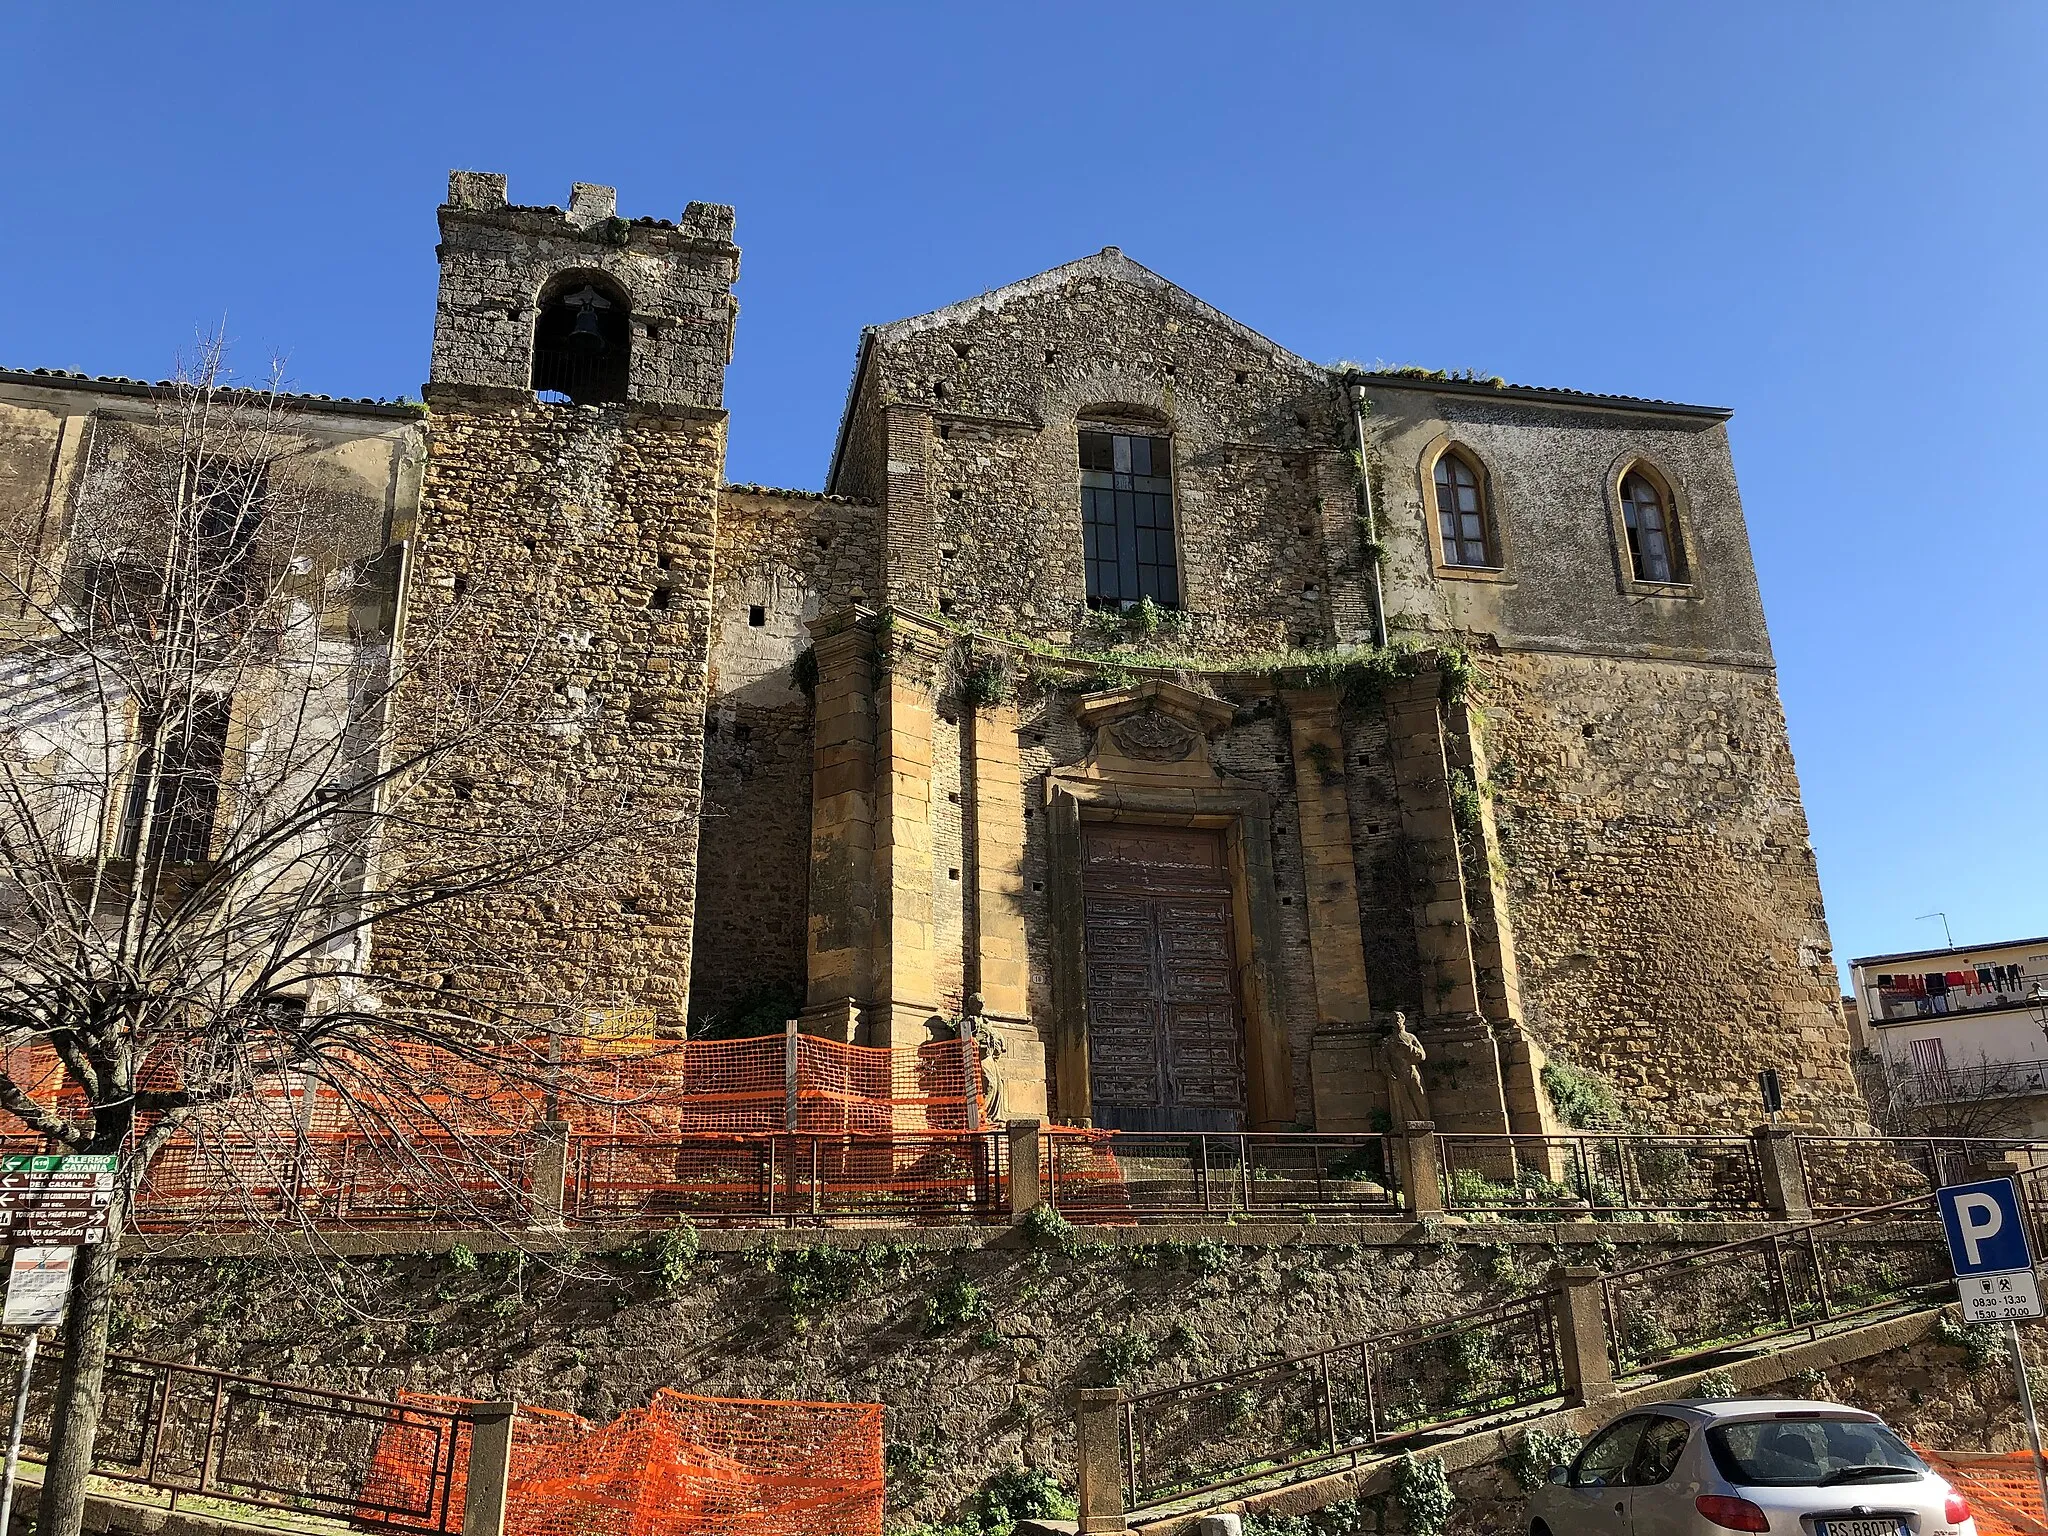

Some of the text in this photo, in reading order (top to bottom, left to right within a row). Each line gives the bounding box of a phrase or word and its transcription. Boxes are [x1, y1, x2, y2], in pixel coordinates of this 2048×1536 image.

[61, 1156, 111, 1164] PALERMO
[1953, 1192, 2003, 1266] P
[1972, 1297, 1997, 1308] 08.30
[2003, 1295, 2027, 1305] 13.30
[1974, 1310, 1997, 1319] 15.30
[2003, 1307, 2029, 1317] 20.00
